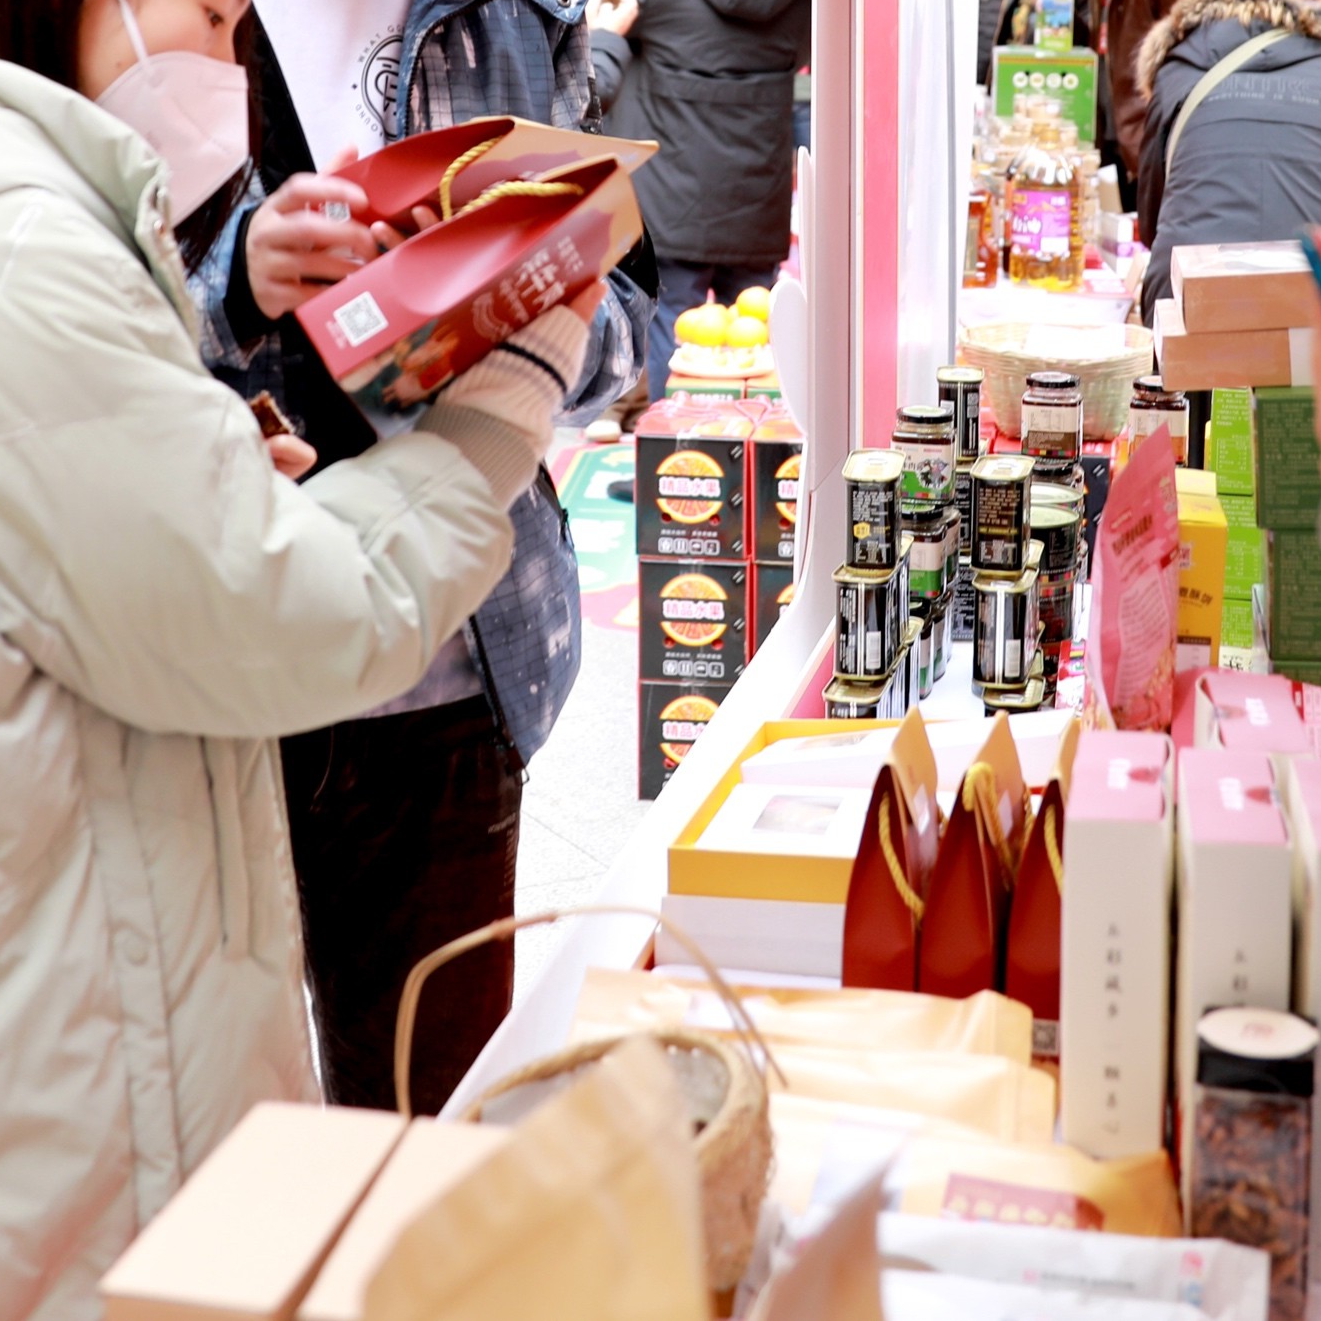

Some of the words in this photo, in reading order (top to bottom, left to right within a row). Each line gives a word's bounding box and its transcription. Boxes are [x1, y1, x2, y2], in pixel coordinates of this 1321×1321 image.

[659, 477, 720, 497] 精品水果
[664, 600, 726, 620] 精品水果
